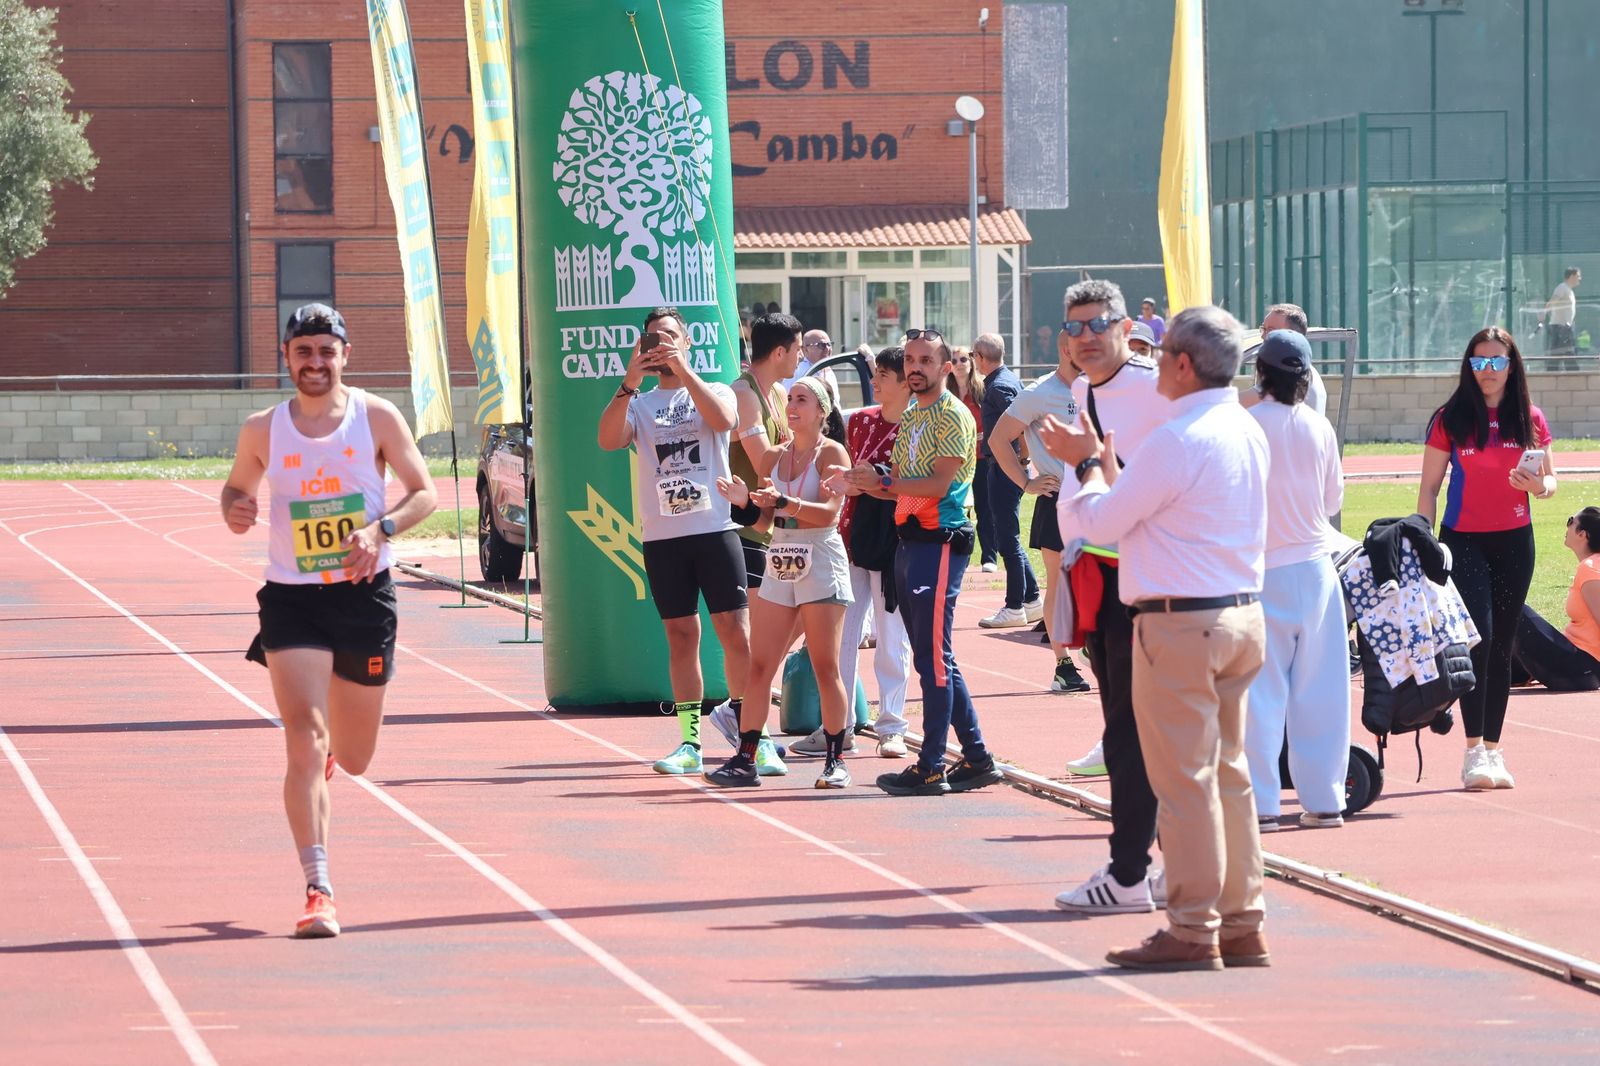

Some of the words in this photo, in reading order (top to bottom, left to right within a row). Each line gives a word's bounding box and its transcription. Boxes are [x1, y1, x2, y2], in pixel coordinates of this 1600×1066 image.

[560, 321, 720, 351] FUNDON
[562, 351, 628, 380] CAJA
[1461, 448, 1475, 456] 21K
[660, 482, 671, 490] 10K
[665, 486, 702, 504] 745
[299, 517, 354, 551] 160
[771, 555, 806, 570] 970
